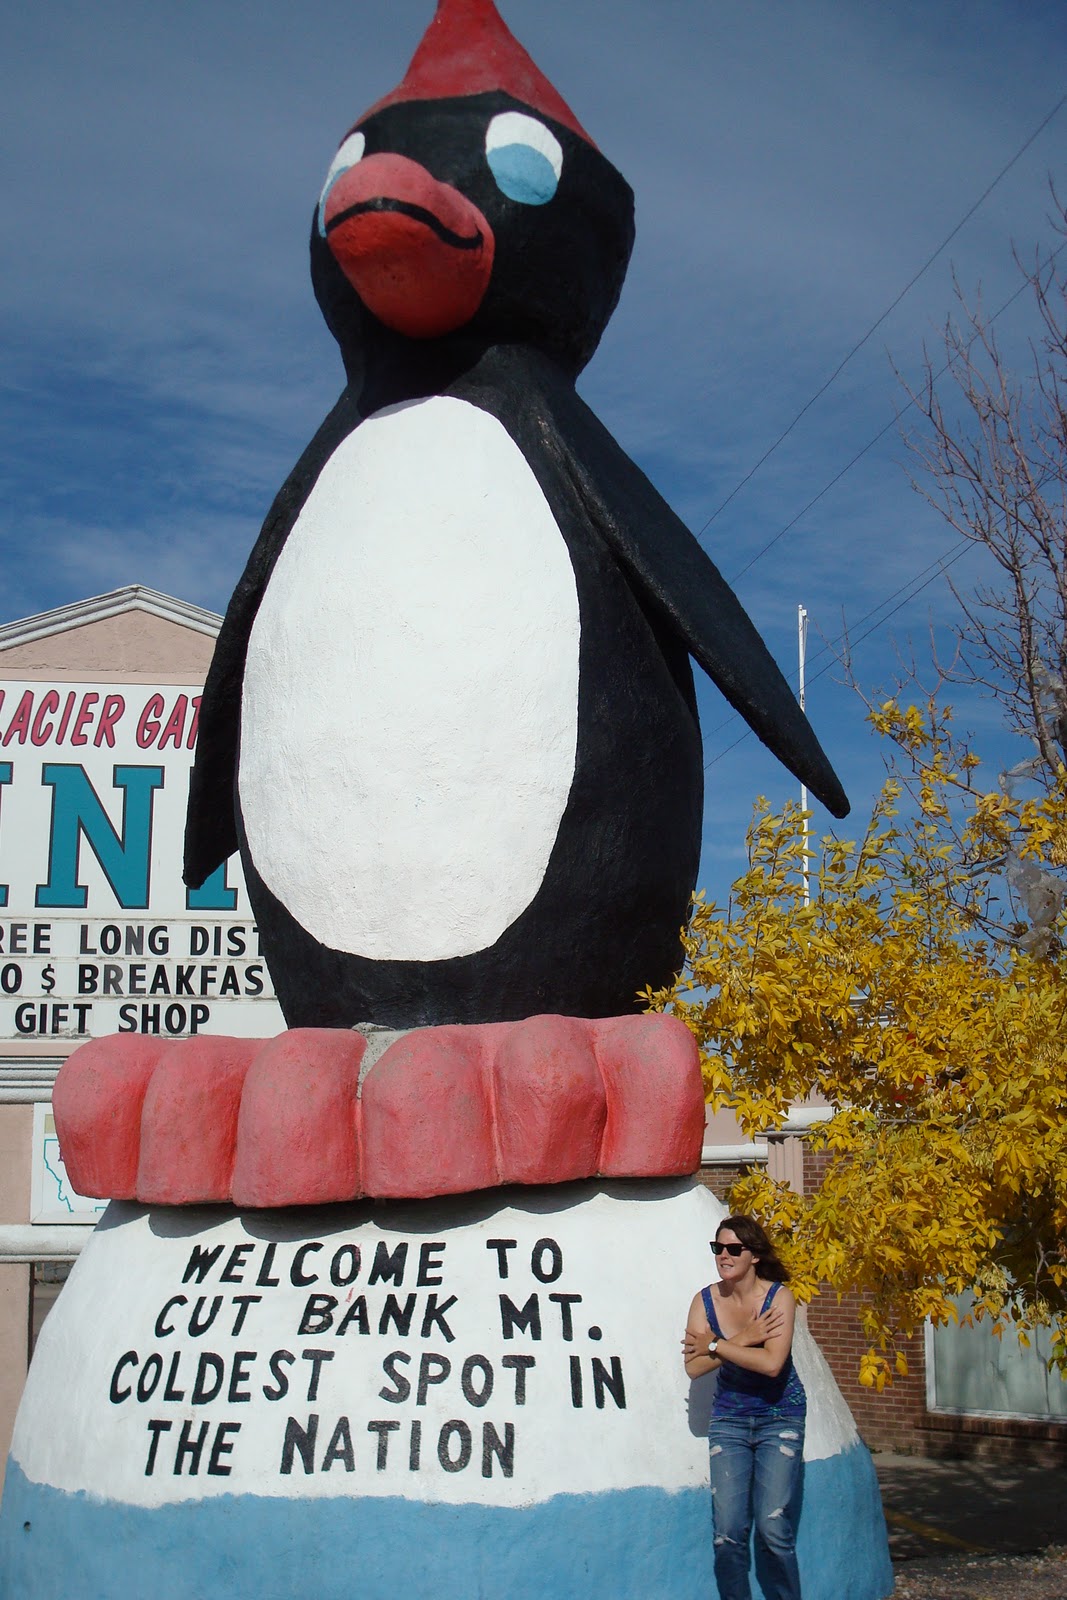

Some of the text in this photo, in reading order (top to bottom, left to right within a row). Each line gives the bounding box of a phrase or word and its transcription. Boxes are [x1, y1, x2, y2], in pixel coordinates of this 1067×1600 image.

[0, 923, 51, 954] EE
[79, 924, 169, 956] LONG
[78, 963, 277, 996] BREAKFAS
[15, 1002, 210, 1034] GIFT SHOP
[181, 1237, 563, 1287] WELCOME TO
[154, 1293, 603, 1343] CUT BANK MT.
[109, 1349, 627, 1409] COLDEST SPOT IN
[144, 1413, 515, 1478] THE NATION
